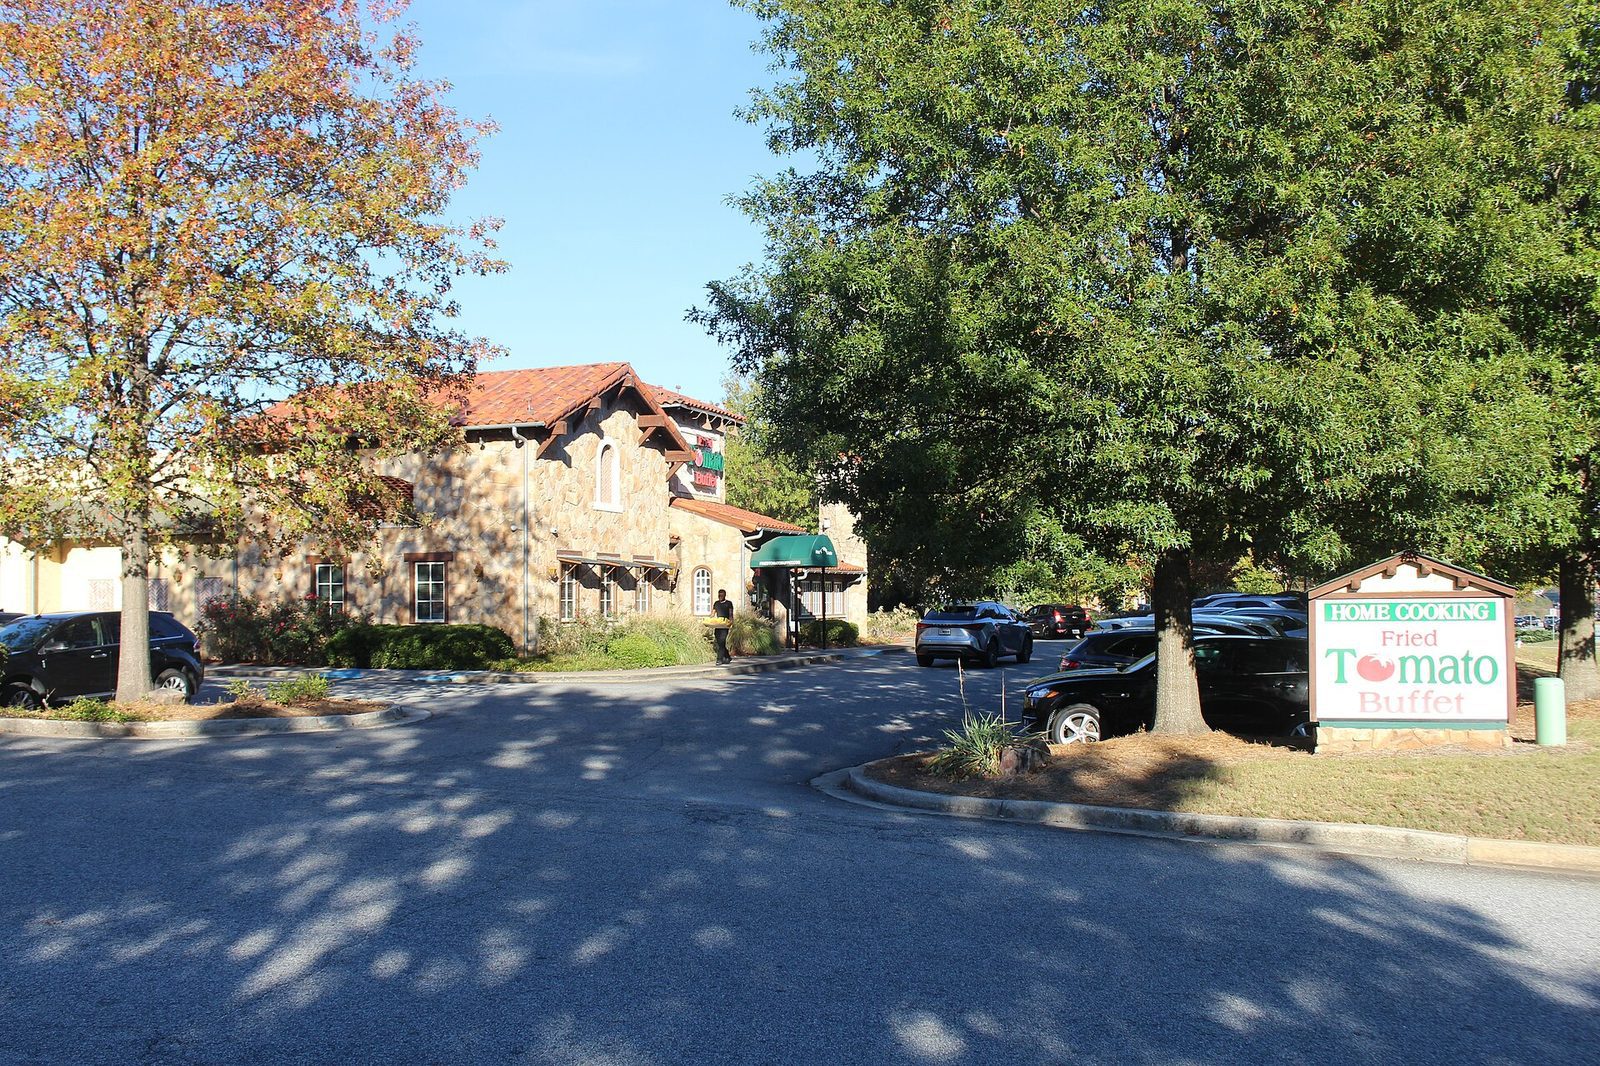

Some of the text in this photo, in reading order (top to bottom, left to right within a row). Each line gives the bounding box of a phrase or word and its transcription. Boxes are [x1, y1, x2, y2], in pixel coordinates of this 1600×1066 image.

[1331, 603, 1489, 620] HOME COOKING
[1381, 630, 1438, 646] Fried
[1358, 690, 1464, 714] Buffet
